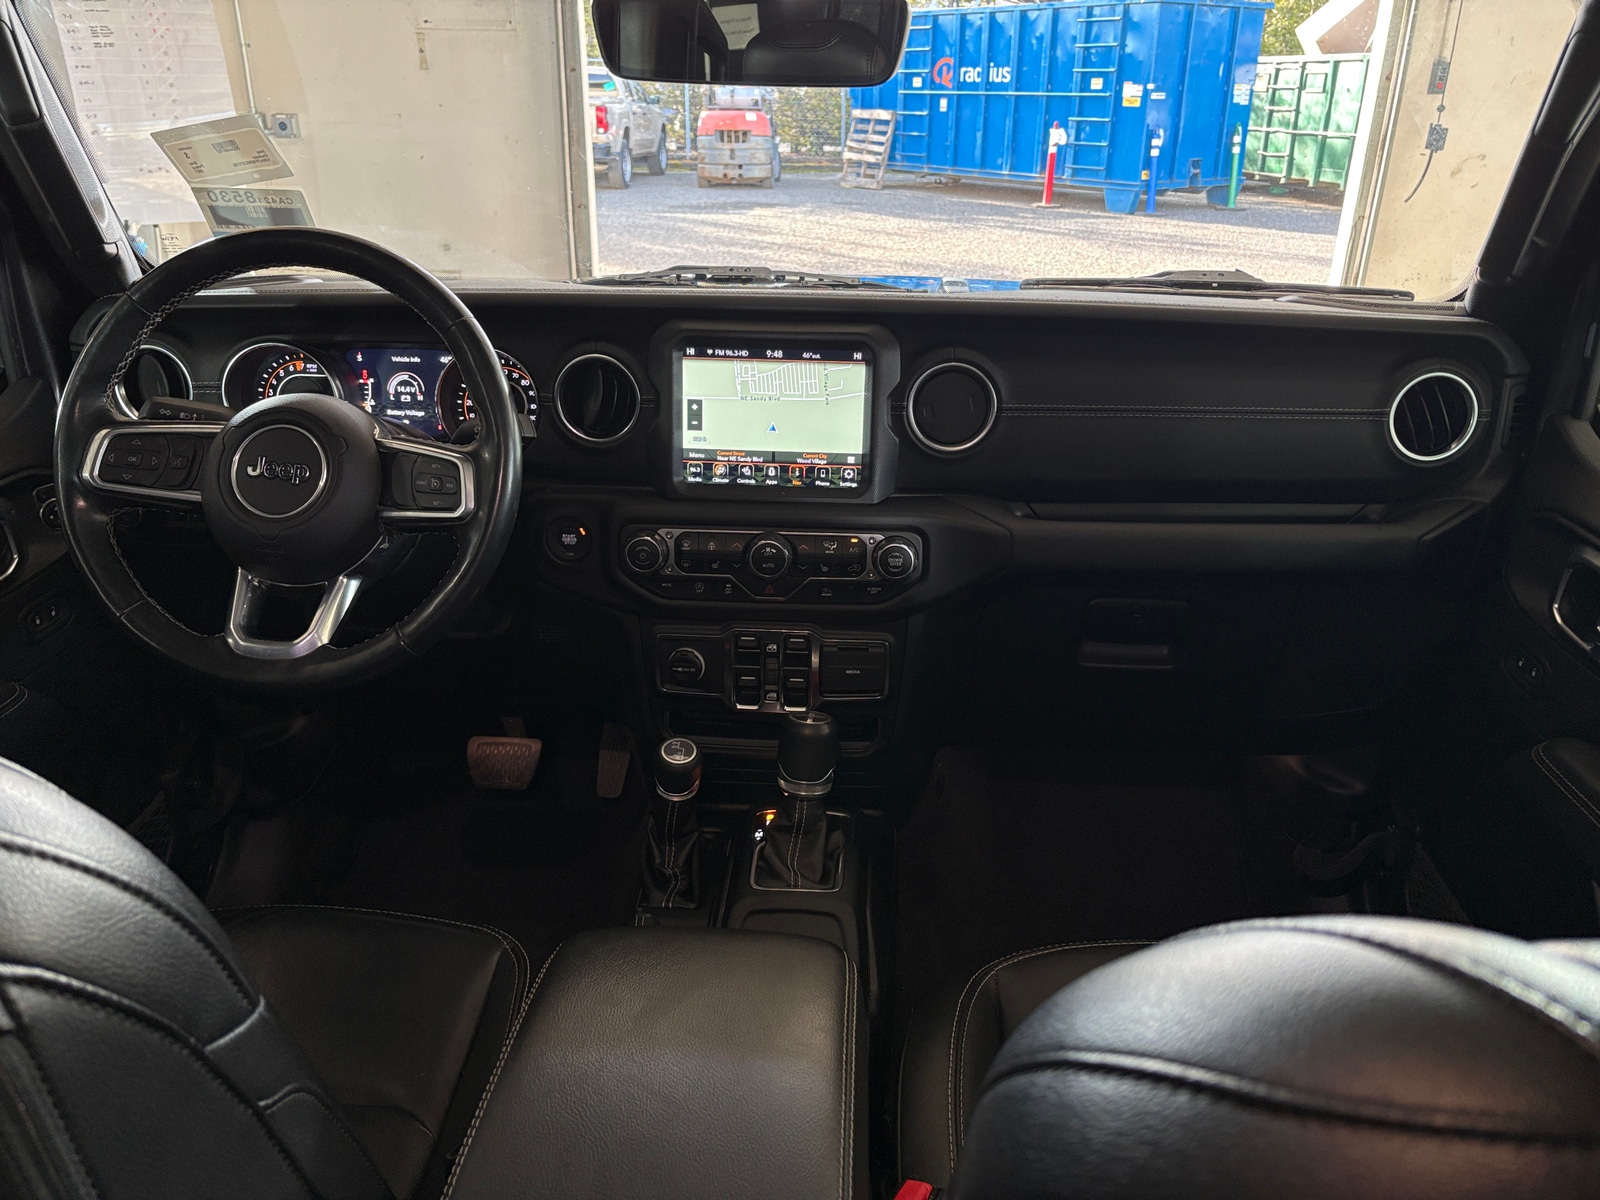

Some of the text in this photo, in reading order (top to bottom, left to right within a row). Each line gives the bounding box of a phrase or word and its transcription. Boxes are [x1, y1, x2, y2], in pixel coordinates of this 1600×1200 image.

[686, 347, 695, 355] HI
[766, 350, 783, 359] 9:48
[391, 355, 410, 363] Vehicle
[853, 352, 862, 360] HI
[279, 369, 285, 377] 5
[396, 385, 410, 393] 14.4
[405, 409, 425, 417] Voltage
[246, 456, 310, 484] Jeep
